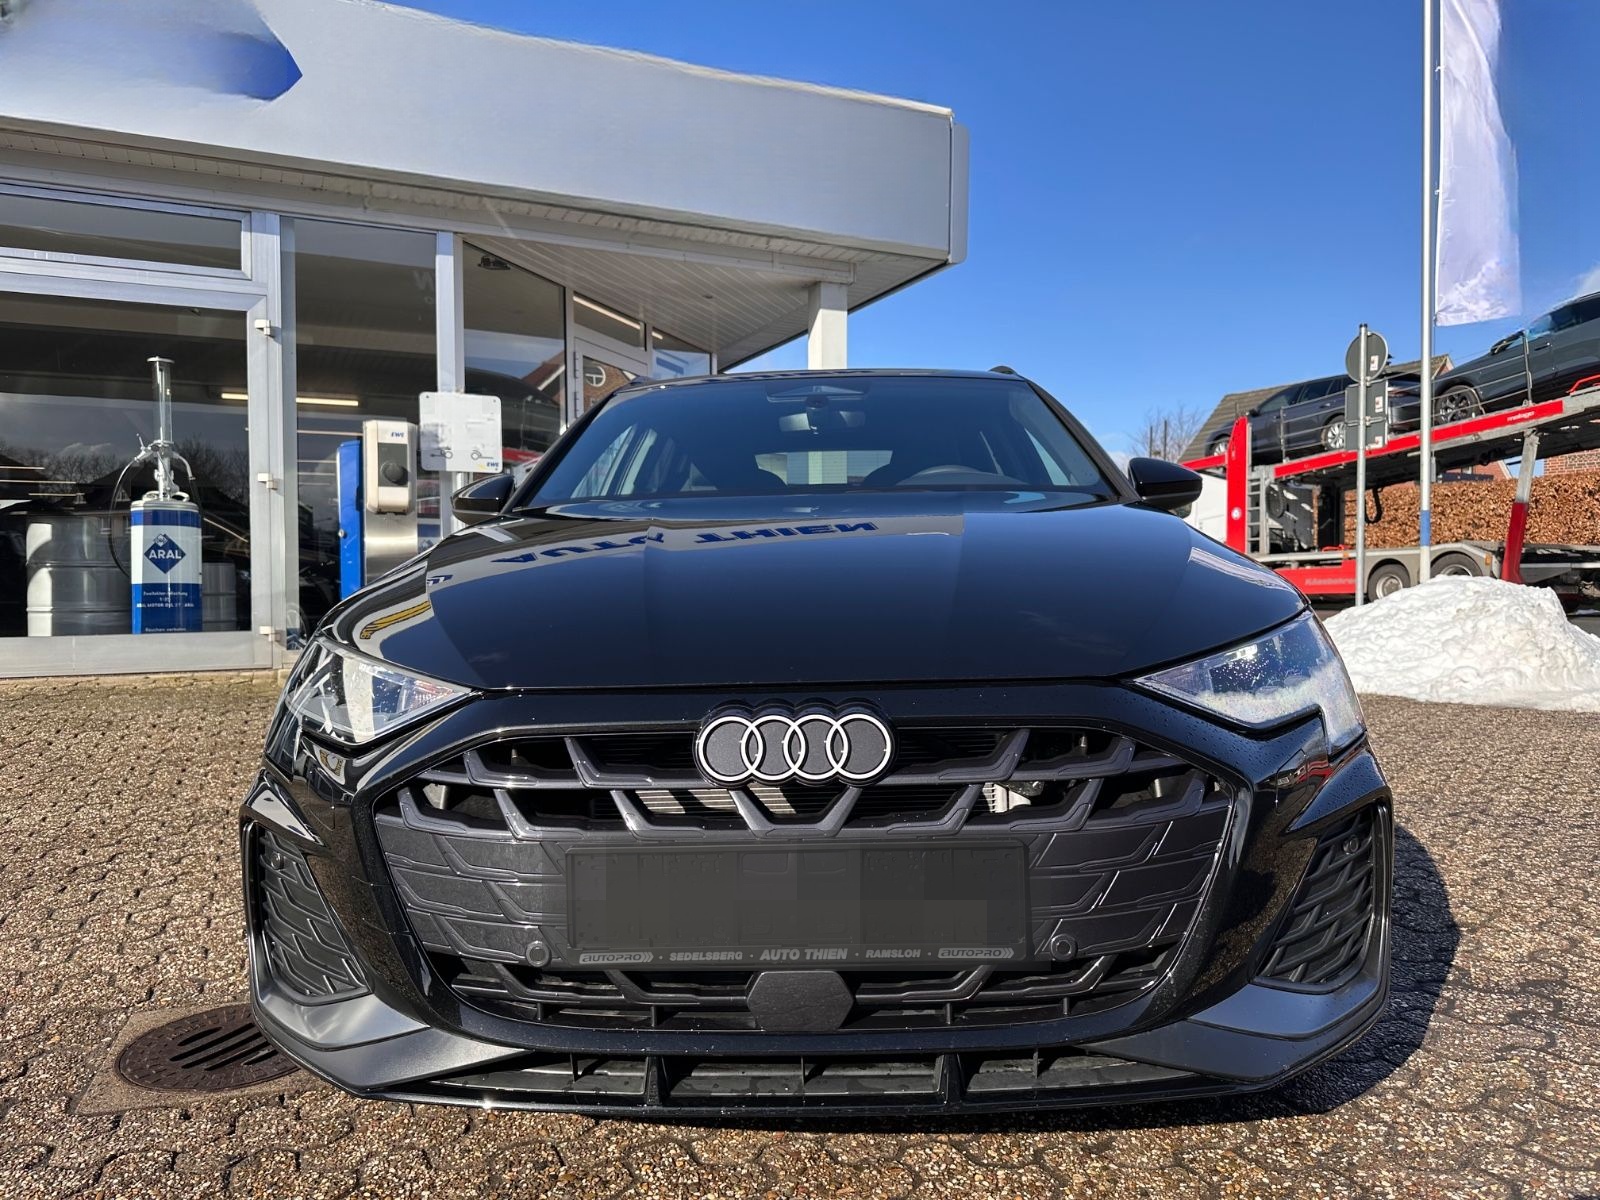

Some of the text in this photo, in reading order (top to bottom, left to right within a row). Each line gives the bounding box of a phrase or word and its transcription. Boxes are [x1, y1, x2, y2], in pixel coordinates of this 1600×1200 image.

[149, 549, 182, 559] ARAL
[669, 952, 743, 961] SEDELSBERG
[760, 949, 800, 961] AUTO
[804, 948, 848, 960] THIEN
[865, 949, 921, 958] RAMSLOH
